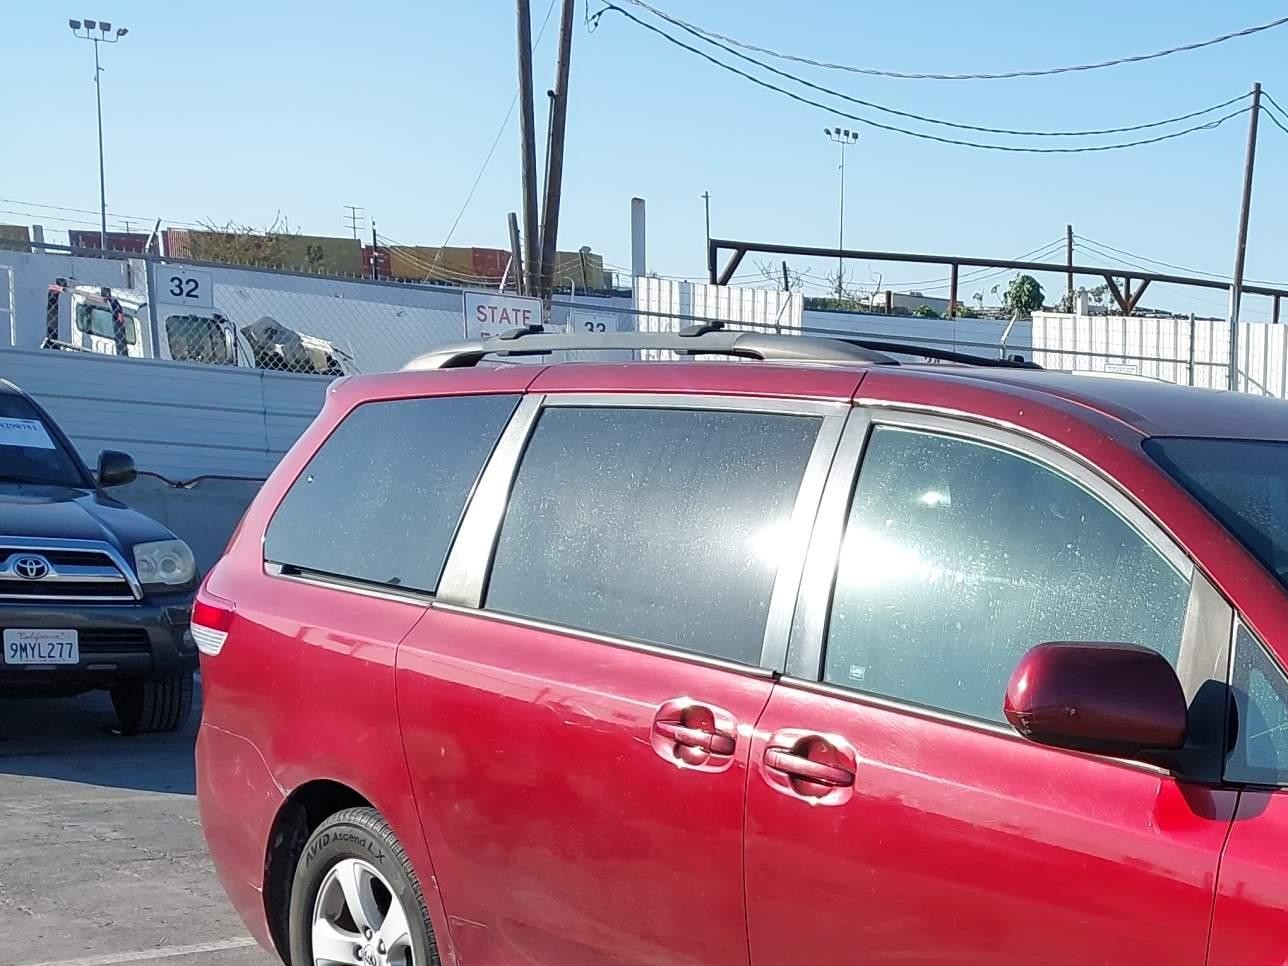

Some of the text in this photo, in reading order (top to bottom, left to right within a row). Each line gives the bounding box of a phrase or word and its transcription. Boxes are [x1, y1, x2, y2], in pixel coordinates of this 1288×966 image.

[169, 276, 200, 299] 32
[476, 305, 533, 326] STATE
[9, 642, 74, 659] 9MYL277
[305, 832, 386, 868] AVID Ascend LX
